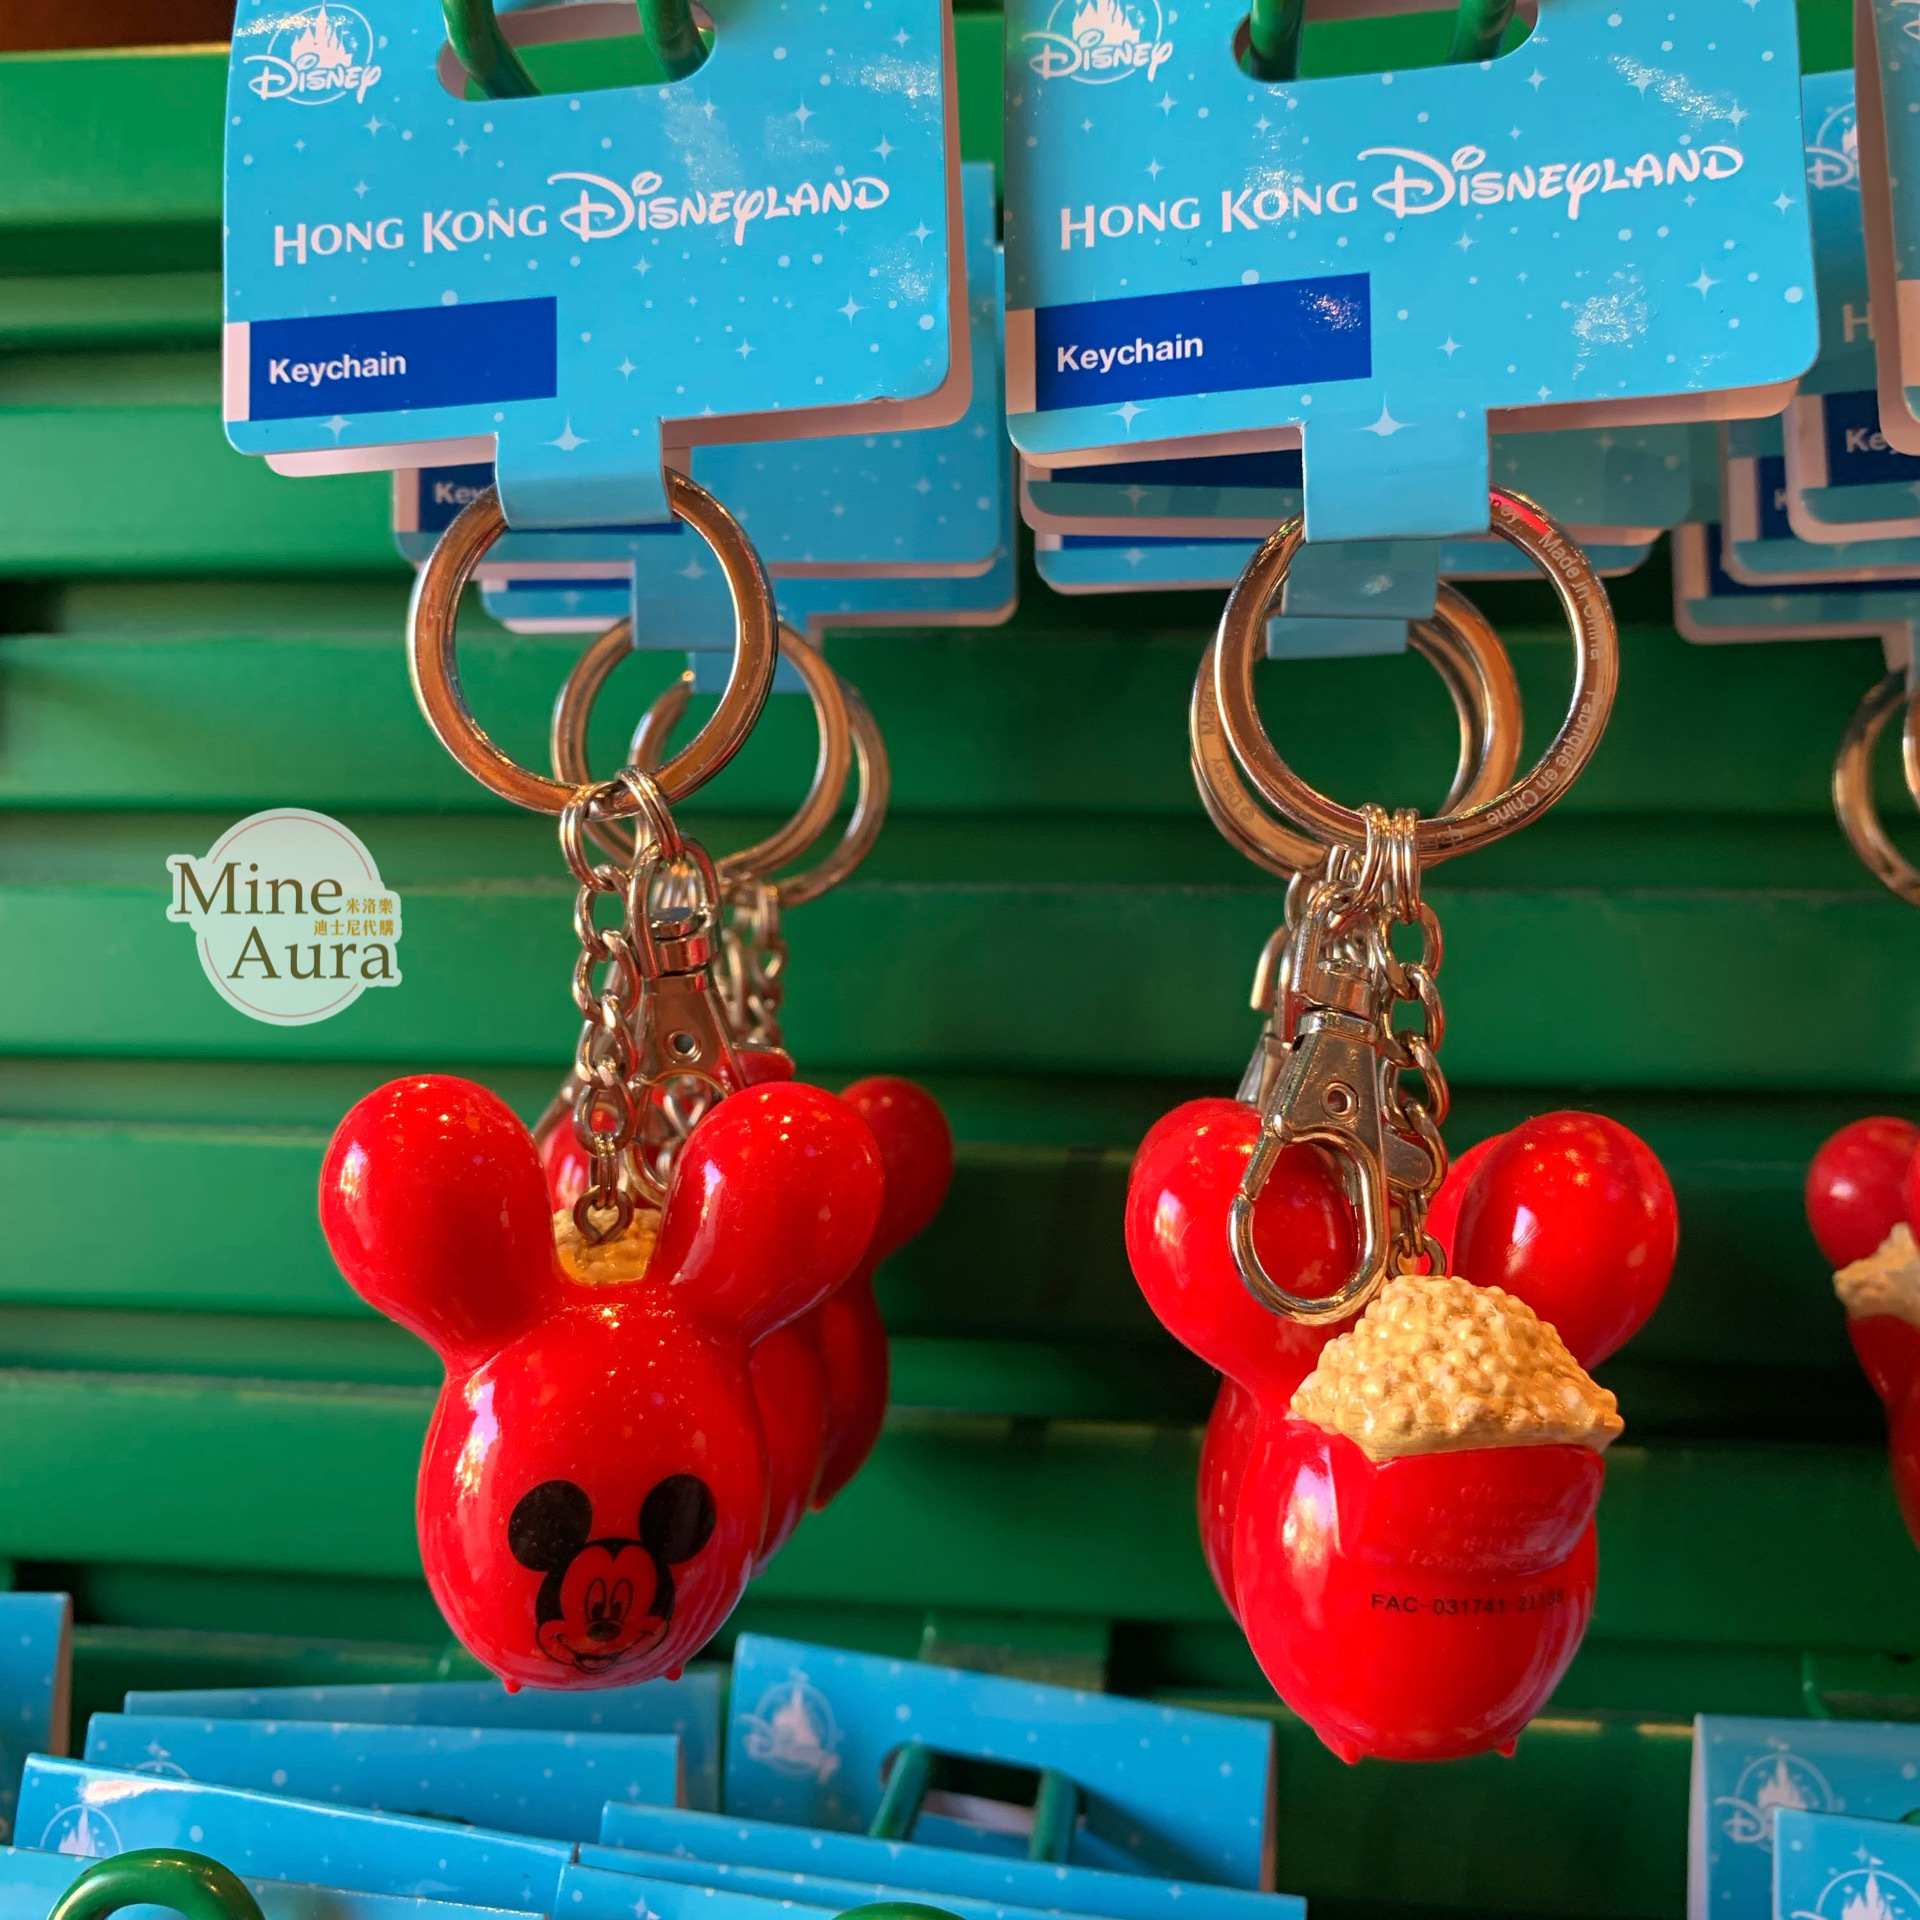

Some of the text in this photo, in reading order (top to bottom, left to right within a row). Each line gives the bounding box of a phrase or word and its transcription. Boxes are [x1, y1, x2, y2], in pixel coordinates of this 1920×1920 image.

[273, 217, 404, 267] HONG
[422, 204, 548, 254] KONG
[1059, 196, 1201, 251] HONG
[1220, 181, 1358, 233] KONG
[268, 352, 407, 388] Keychain
[1056, 334, 1204, 374] Keychain
[1538, 531, 1580, 579] Made
[1583, 602, 1604, 661] China
[1536, 768, 1559, 790] en
[1486, 789, 1539, 825] Chine
